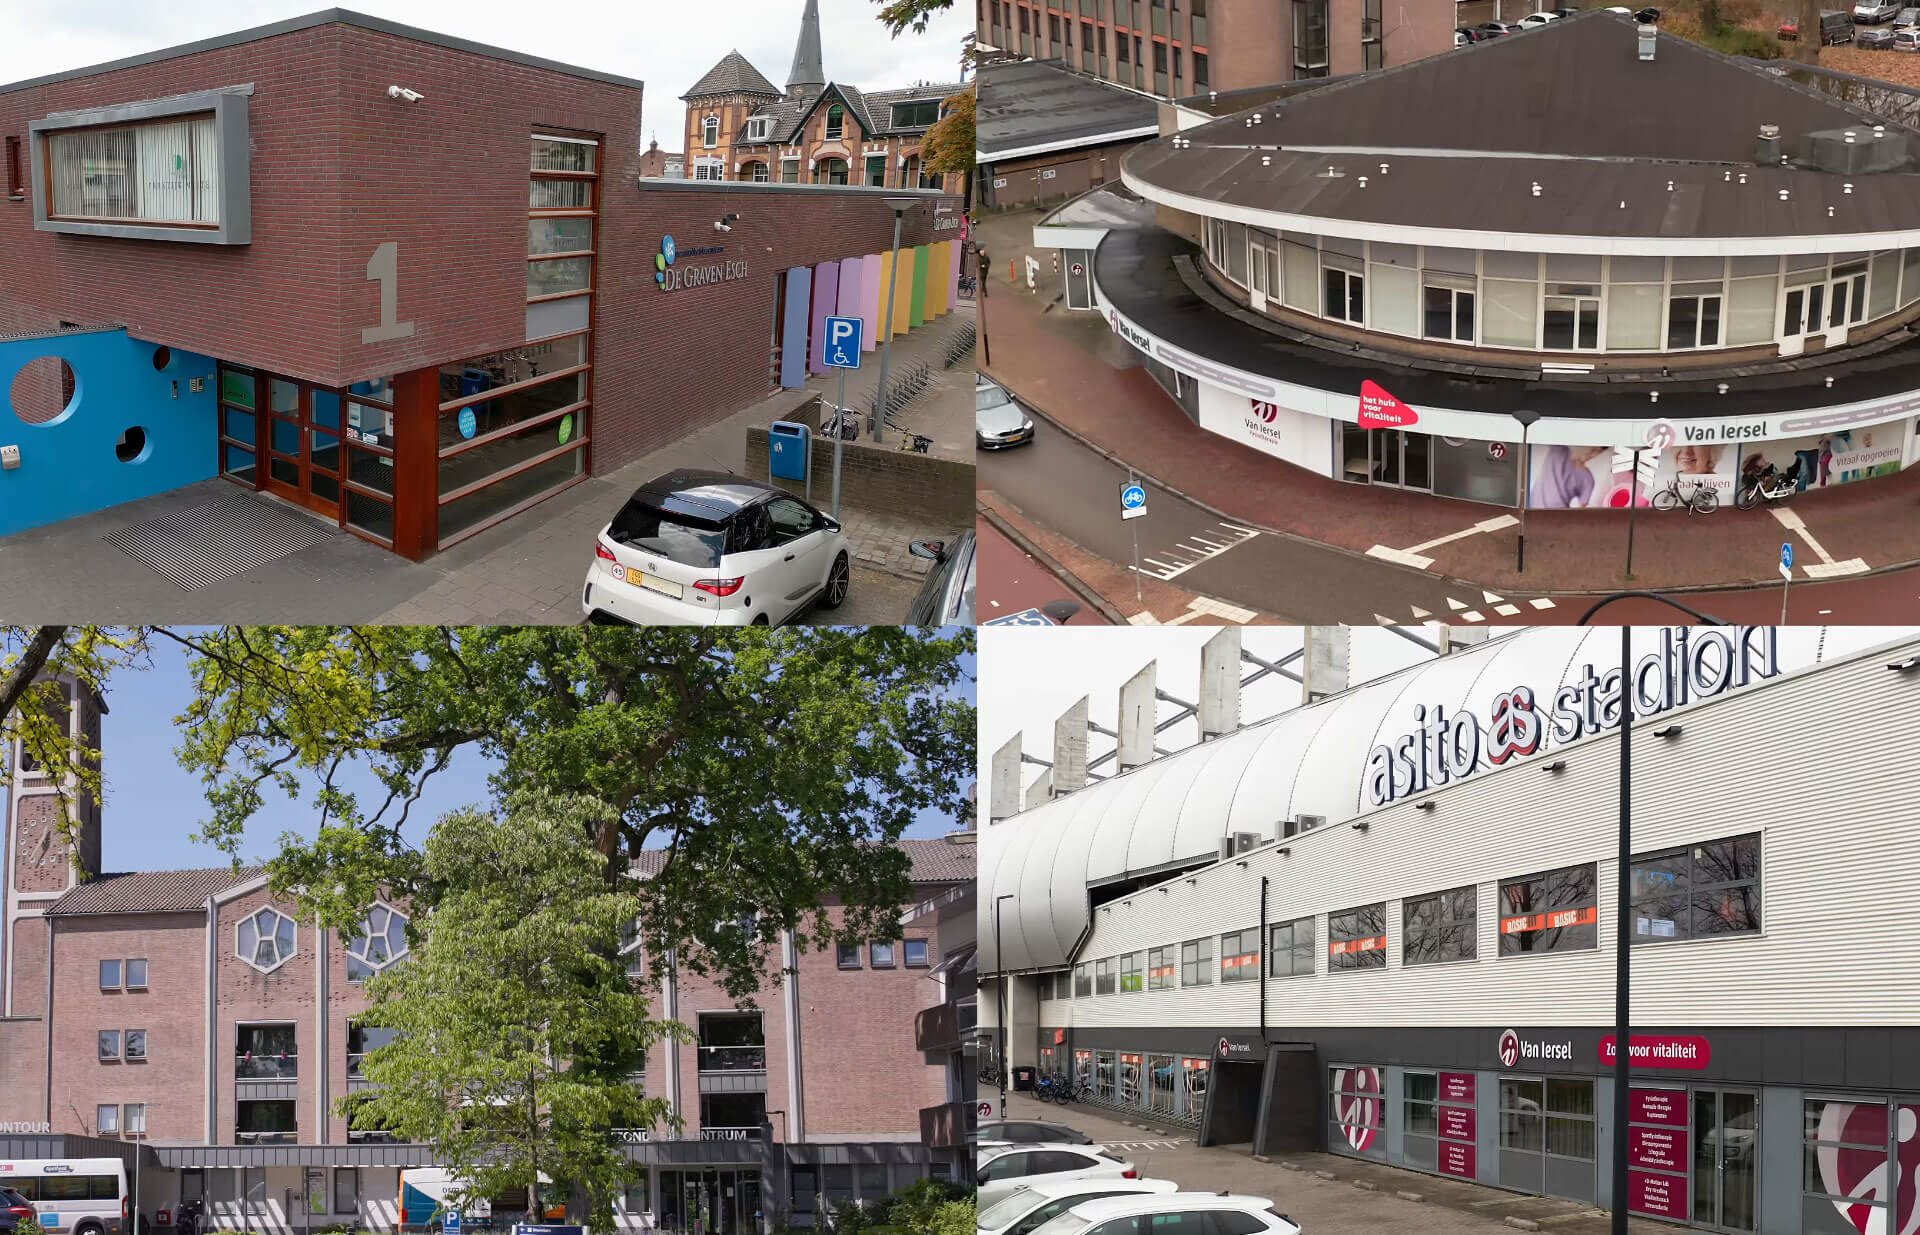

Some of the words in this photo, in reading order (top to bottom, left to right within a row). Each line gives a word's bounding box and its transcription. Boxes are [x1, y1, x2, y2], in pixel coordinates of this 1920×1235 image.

[665, 268, 681, 291] DE
[684, 264, 723, 288] GRAVEN
[726, 260, 748, 281] ESCH
[362, 241, 414, 345] 1
[832, 321, 853, 346] P
[1118, 318, 1130, 338] Van
[1131, 328, 1151, 352] Iersel
[1363, 396, 1377, 405] het
[1378, 397, 1396, 407] huis
[1363, 404, 1382, 412] voor
[1363, 411, 1402, 423] vitaliteit
[1244, 418, 1259, 432] Van
[1260, 423, 1281, 440] Iersel
[1684, 426, 1715, 441] Van
[1721, 421, 1768, 439] Iersel
[1836, 455, 1858, 467] Vitaal
[1860, 447, 1900, 463] opgroeien
[1666, 480, 1694, 489] Vaal
[613, 567, 623, 576] 45
[1369, 703, 1480, 806] asito
[1552, 625, 1778, 744] stadion
[1507, 916, 1527, 933] BASIC
[1554, 910, 1577, 928] BASIC
[1520, 1041, 1539, 1058] Van
[1541, 1041, 1572, 1060] Iersel
[1629, 1045, 1650, 1058] voor
[1652, 1043, 1697, 1059] vitaliteit
[0, 1121, 50, 1133] NTOUR
[447, 1212, 457, 1225] P
